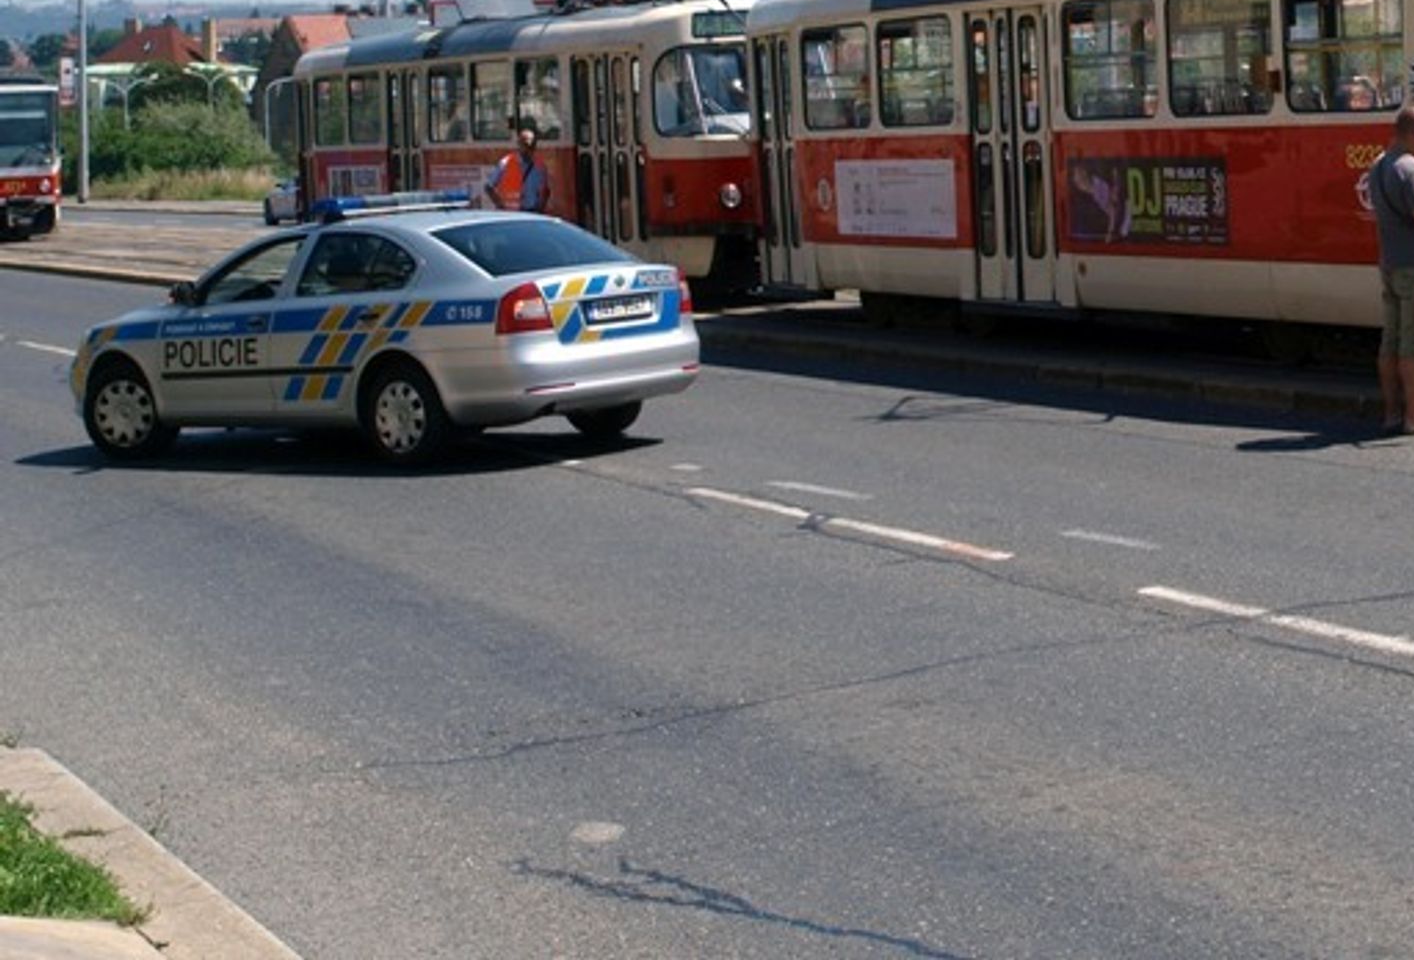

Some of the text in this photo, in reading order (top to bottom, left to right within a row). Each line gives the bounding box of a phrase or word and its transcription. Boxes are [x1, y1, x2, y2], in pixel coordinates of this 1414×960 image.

[1127, 167, 1162, 216] DJ
[1164, 194, 1209, 217] PRAGUE
[164, 337, 259, 369] POLICIE
